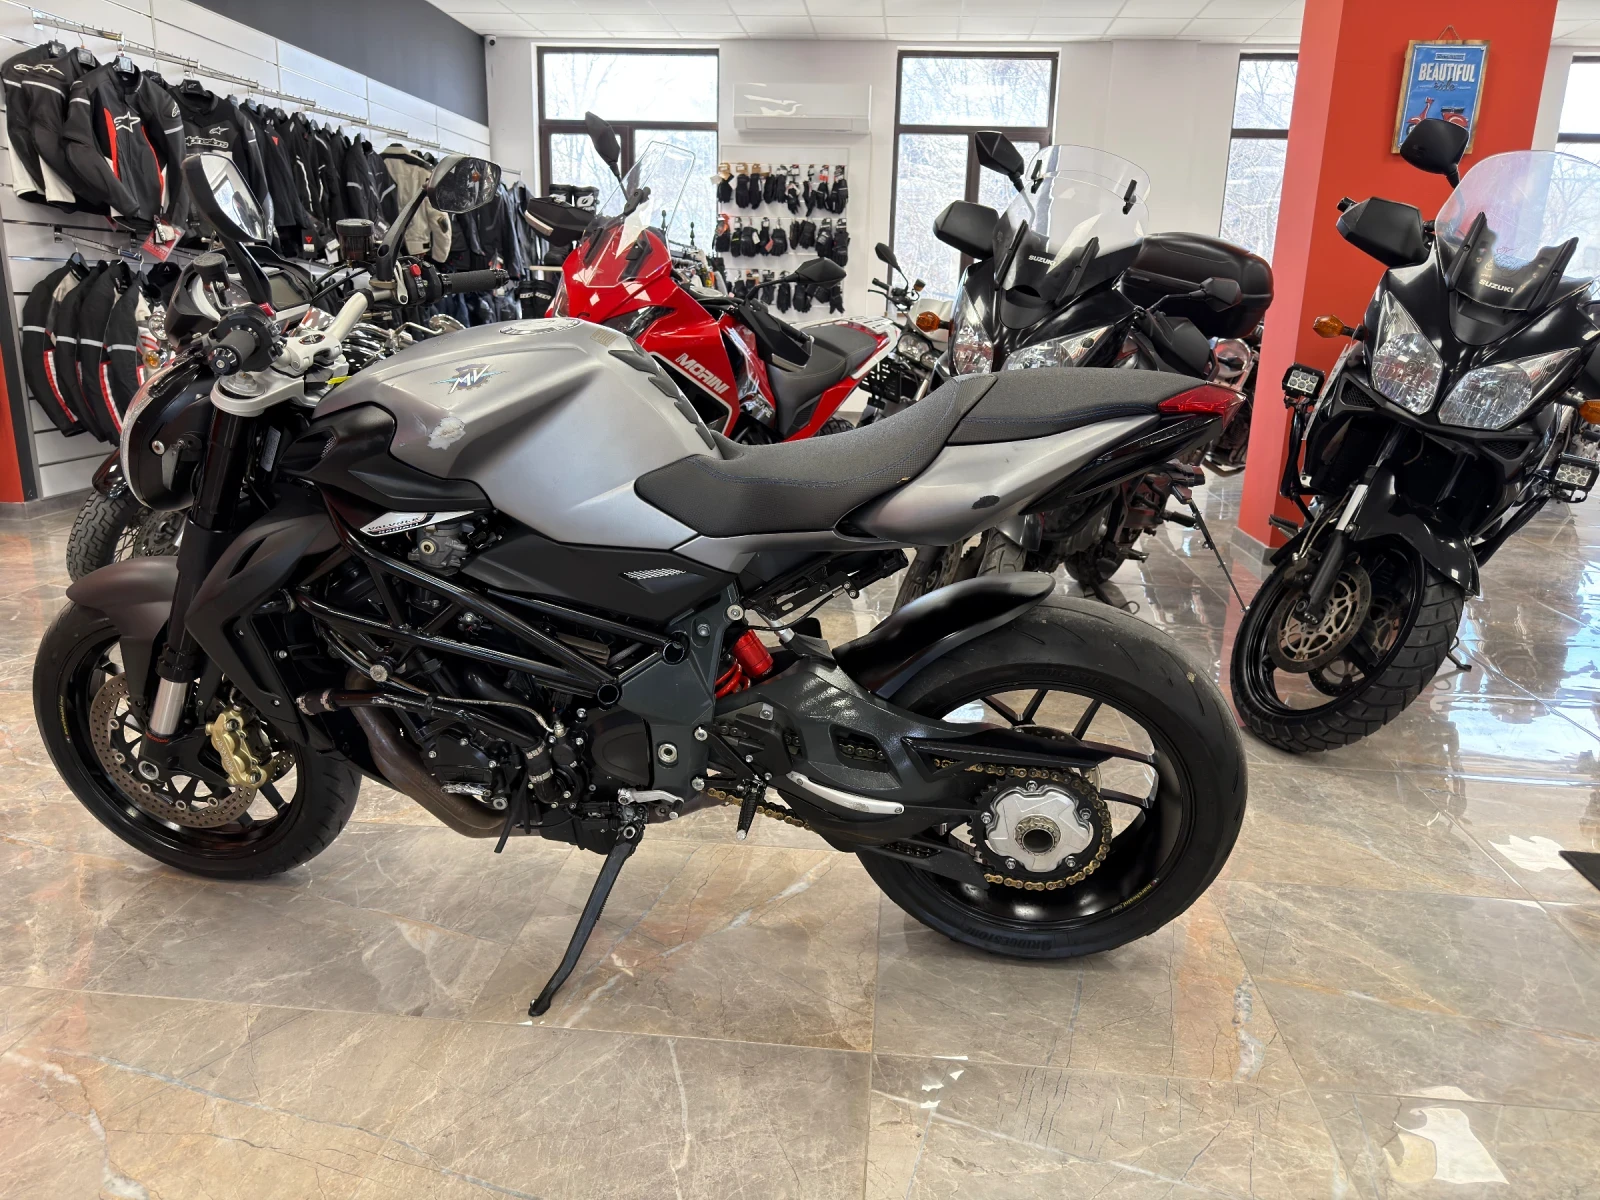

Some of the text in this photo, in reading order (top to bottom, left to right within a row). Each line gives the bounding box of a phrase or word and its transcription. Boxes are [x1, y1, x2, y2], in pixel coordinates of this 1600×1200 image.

[1418, 63, 1476, 82] BEAUTIFUL
[1028, 254, 1056, 266] SUZUKI
[1478, 279, 1514, 293] SUZUKI
[675, 352, 730, 394] MORINI
